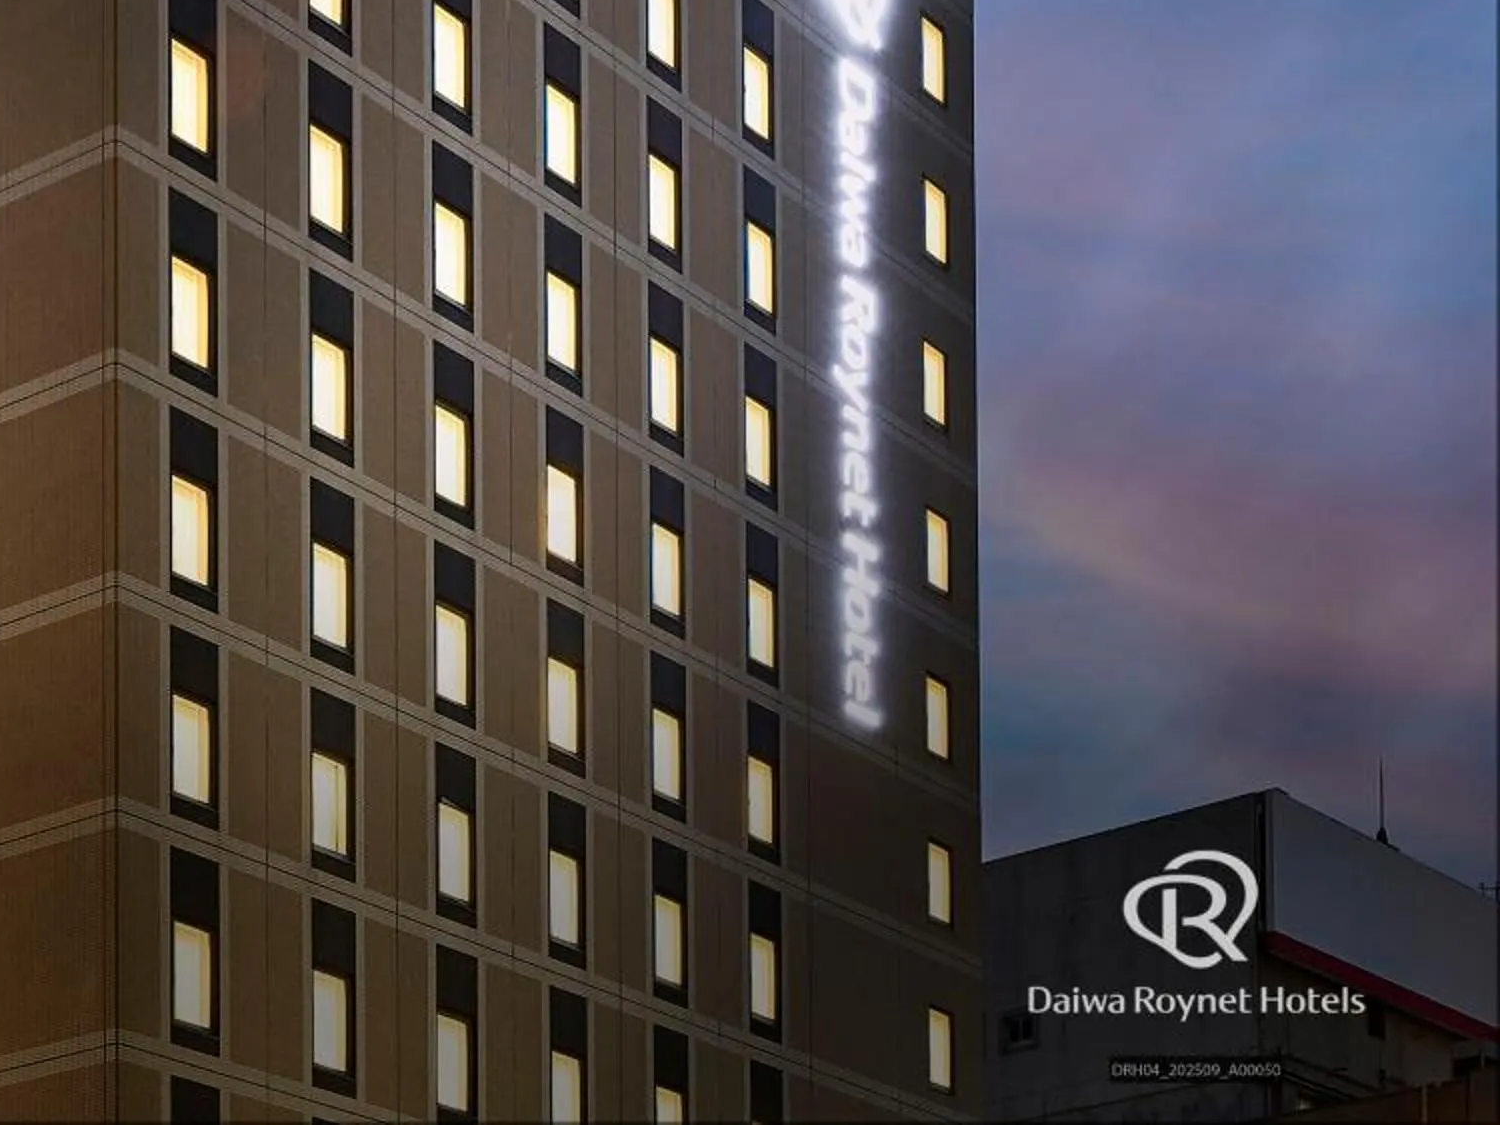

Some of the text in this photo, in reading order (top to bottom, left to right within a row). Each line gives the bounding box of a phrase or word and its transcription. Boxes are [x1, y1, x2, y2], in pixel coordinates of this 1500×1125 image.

[834, 57, 883, 729] Daiwa Roynet Hotel
